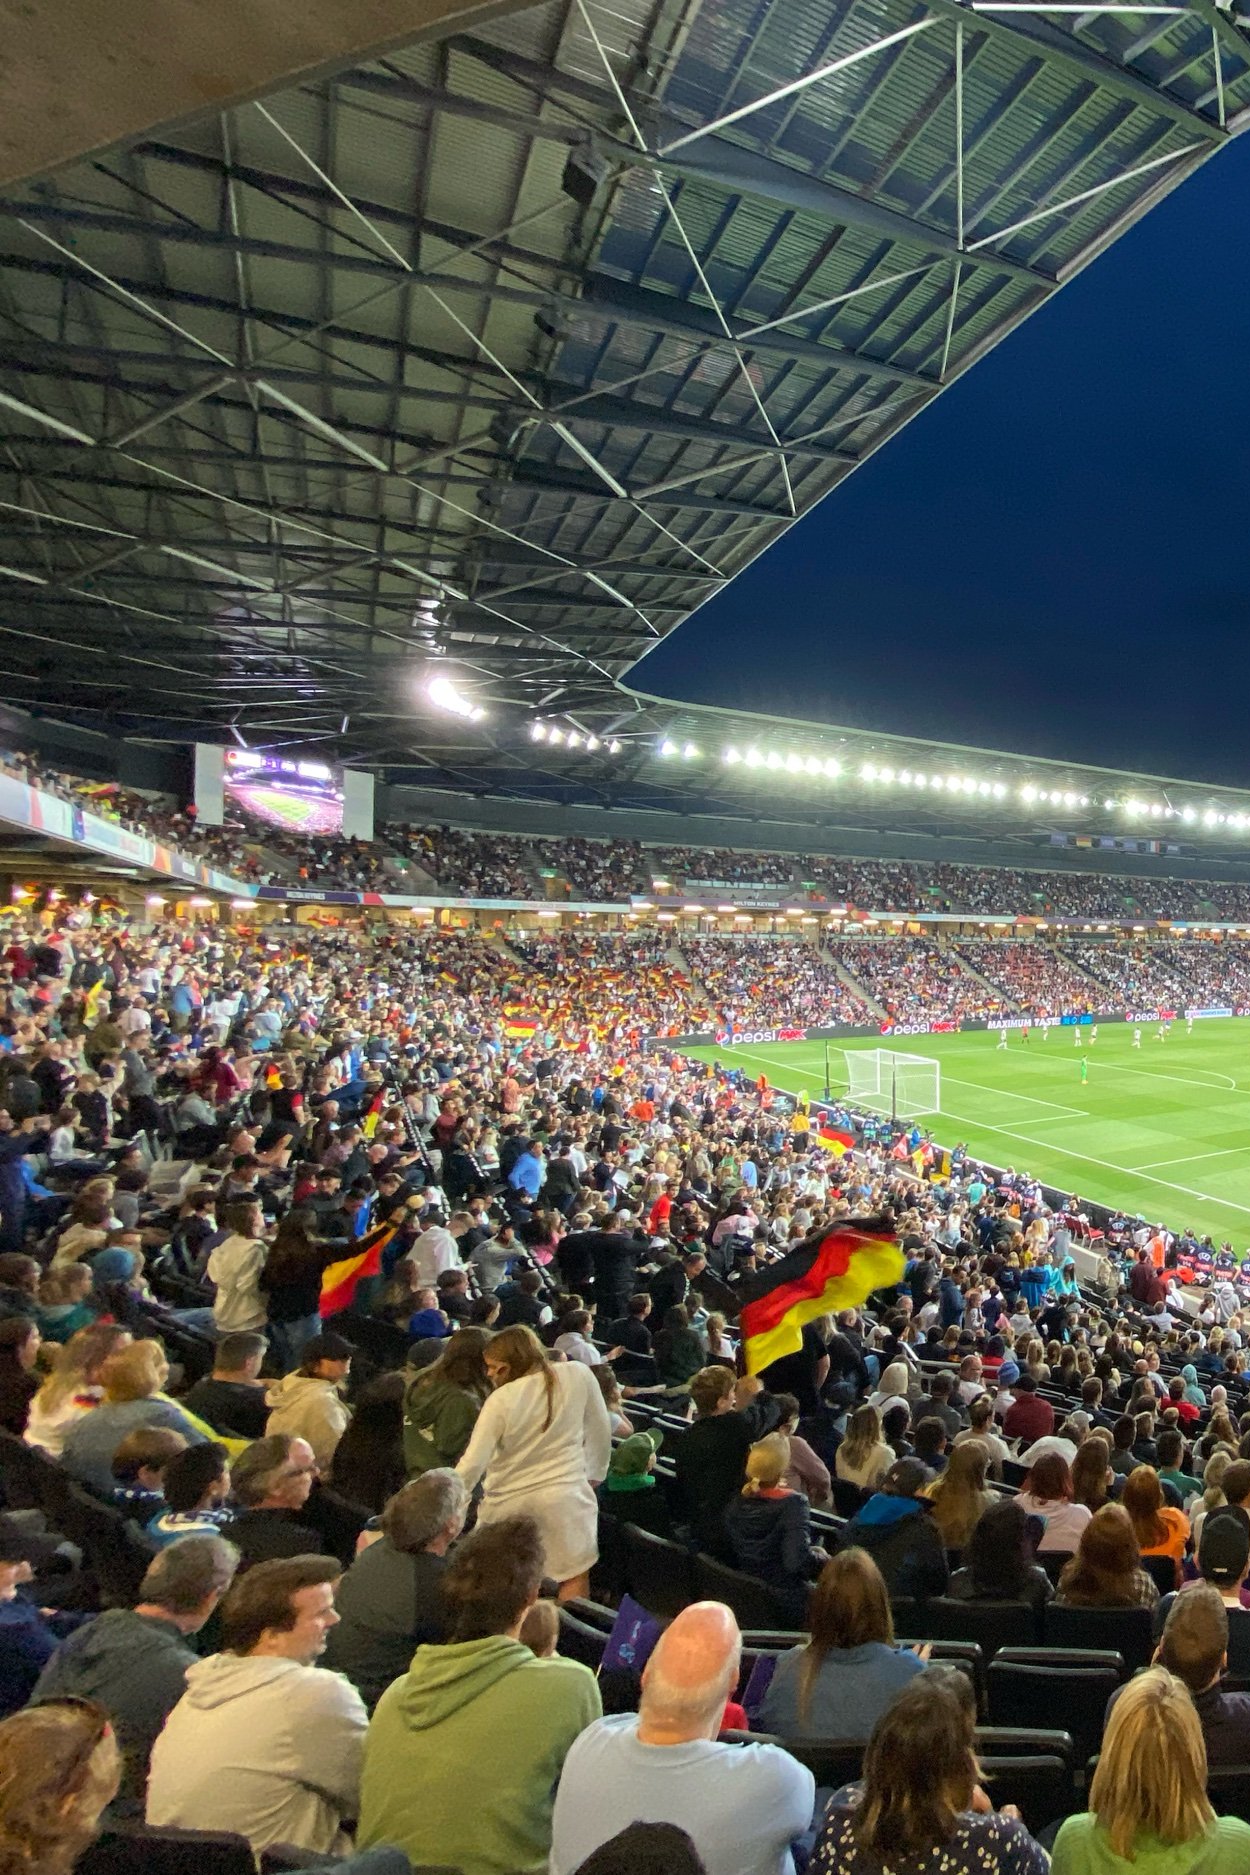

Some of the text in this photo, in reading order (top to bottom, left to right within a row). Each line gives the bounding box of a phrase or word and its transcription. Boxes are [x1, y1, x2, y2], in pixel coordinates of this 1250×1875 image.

[1135, 1011, 1159, 1022] pepsi
[894, 1022, 929, 1035] pepsi
[987, 1019, 1031, 1030] MAXIMUM
[732, 1030, 776, 1045] pepsi
